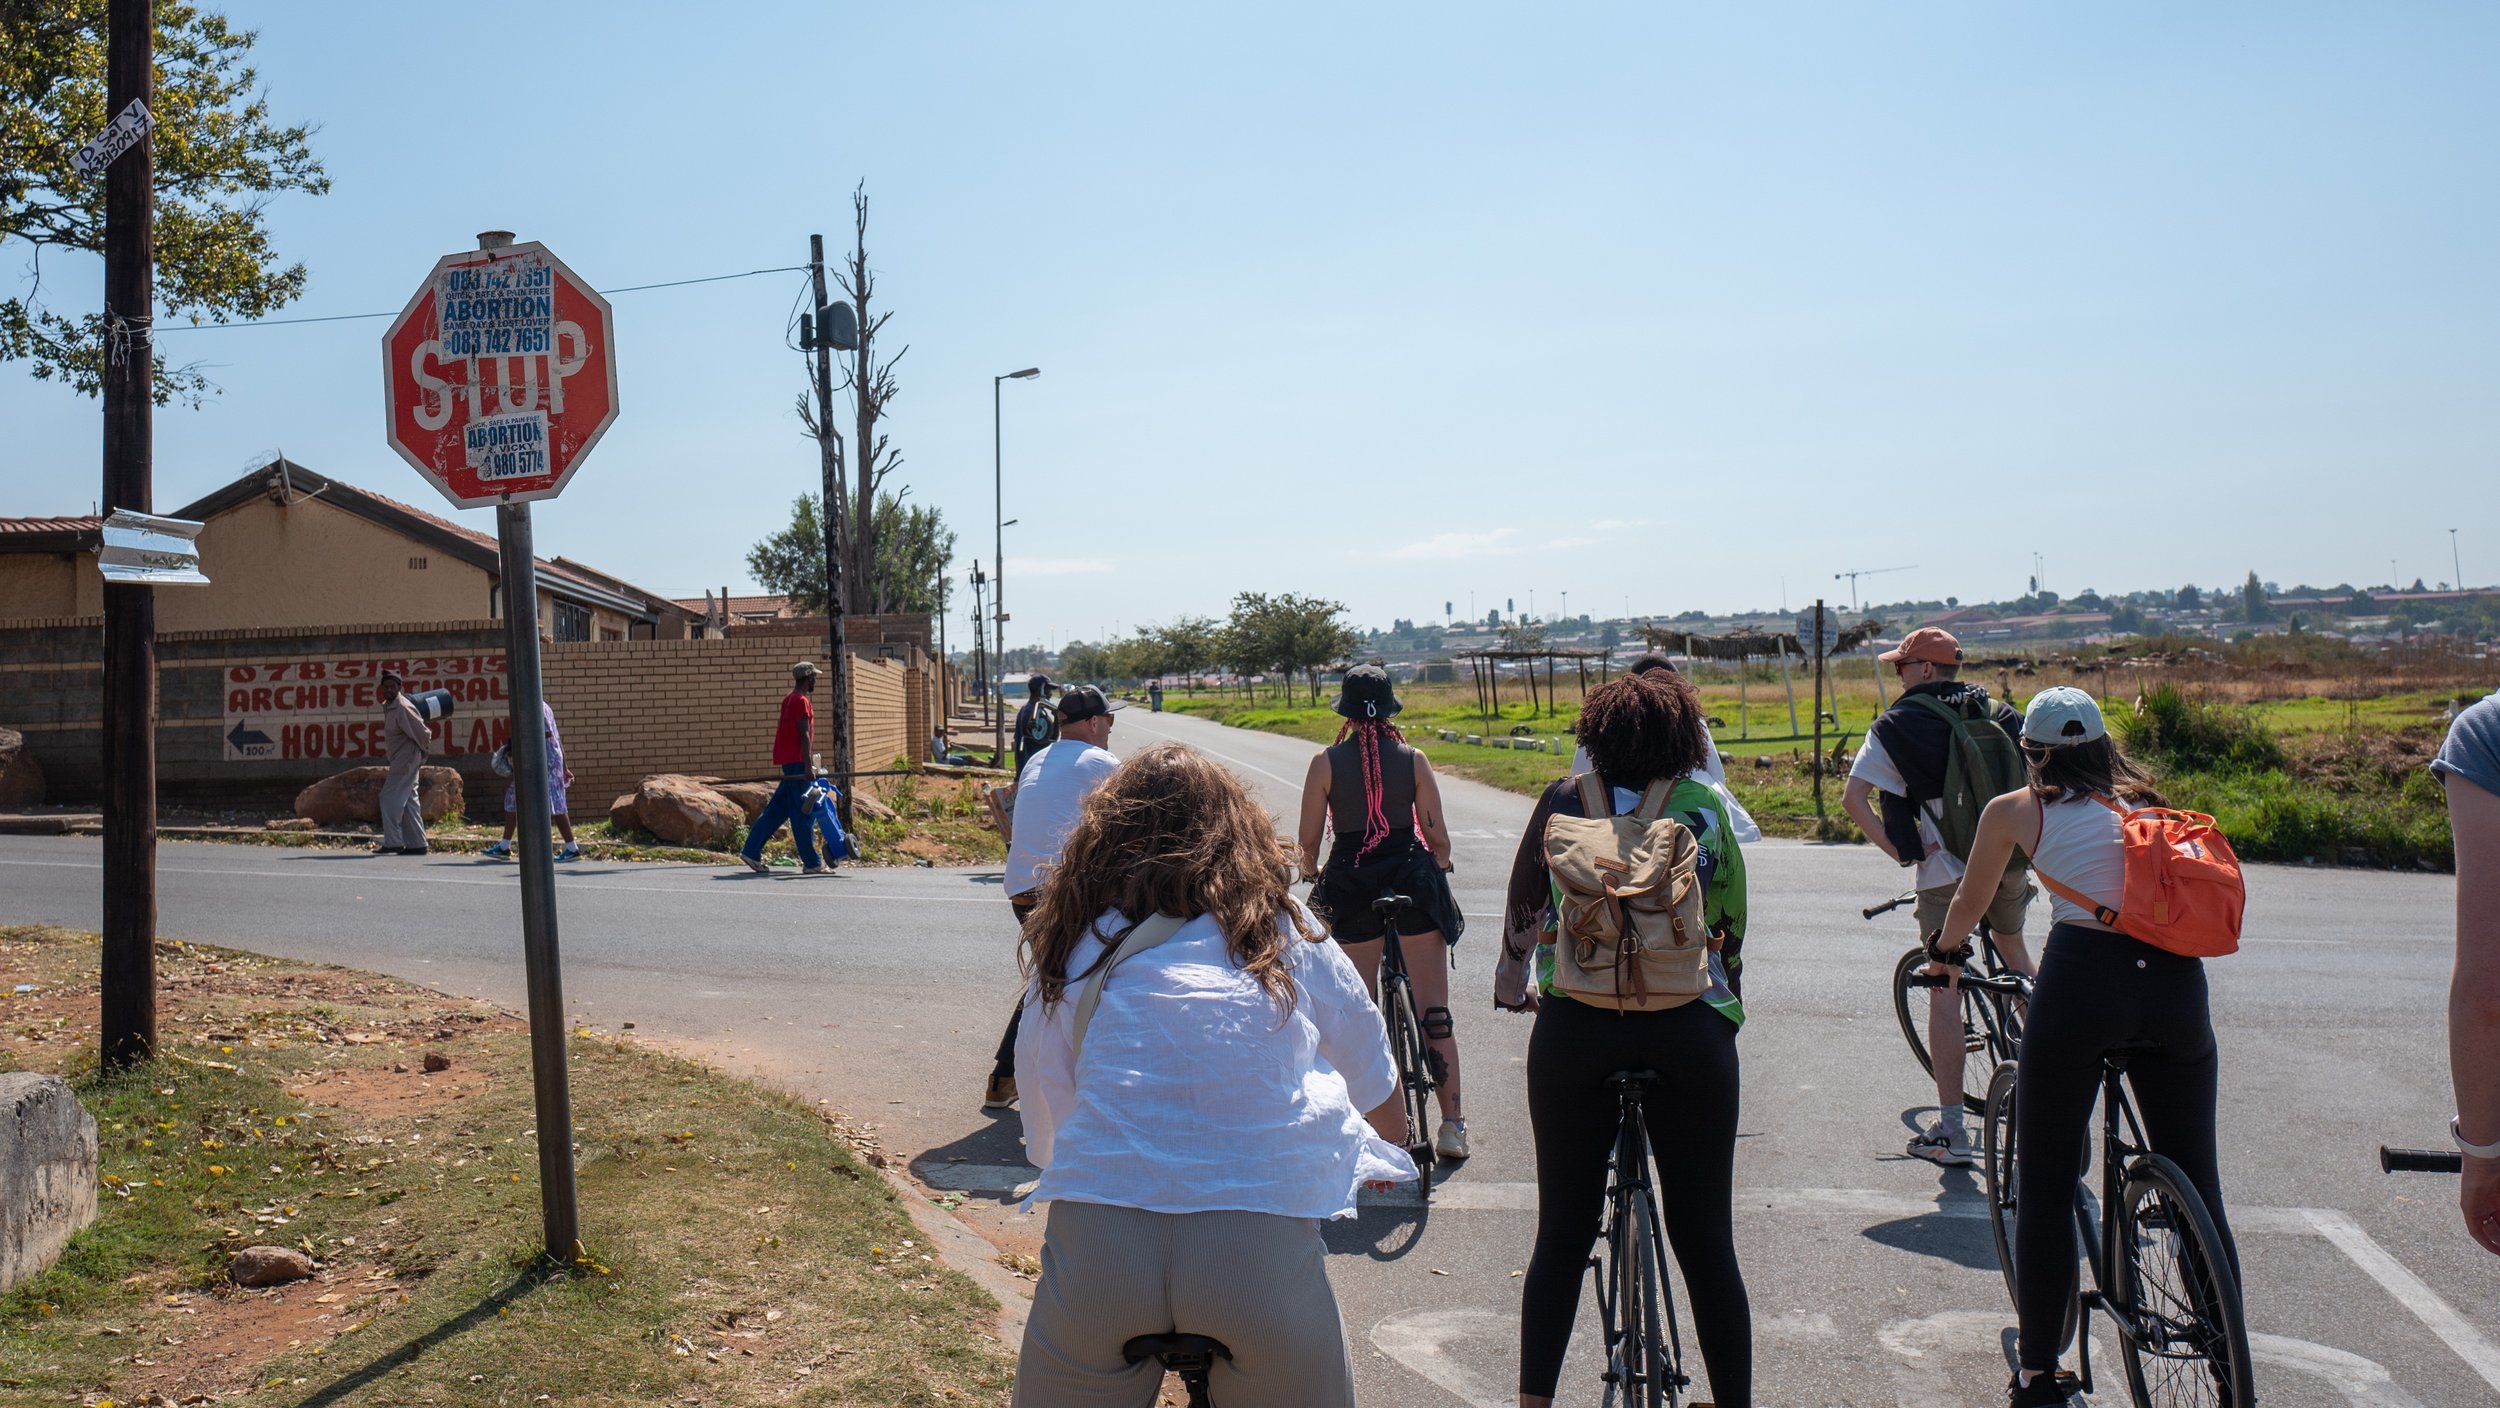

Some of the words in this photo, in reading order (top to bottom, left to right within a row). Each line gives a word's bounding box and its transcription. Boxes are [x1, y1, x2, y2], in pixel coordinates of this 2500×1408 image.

[476, 290, 496, 299] SAFE
[497, 290, 504, 298] &
[507, 289, 527, 297] PAIN
[528, 287, 550, 296] FREE
[444, 296, 550, 322] ABORTION
[444, 322, 467, 330] SAME
[470, 321, 487, 330] DAY
[488, 321, 495, 329] &
[497, 319, 519, 328] LOST
[520, 318, 550, 327] LOVER
[452, 329, 482, 355] 083
[485, 328, 511, 353] 742
[513, 327, 550, 352] 7651
[489, 418, 504, 427] SAFE
[511, 416, 525, 424] PAIN
[467, 421, 543, 449] ABORTION
[499, 443, 534, 453] VICKY
[494, 452, 516, 477] 980
[518, 450, 544, 474] 5774
[282, 720, 386, 759] HOUSE
